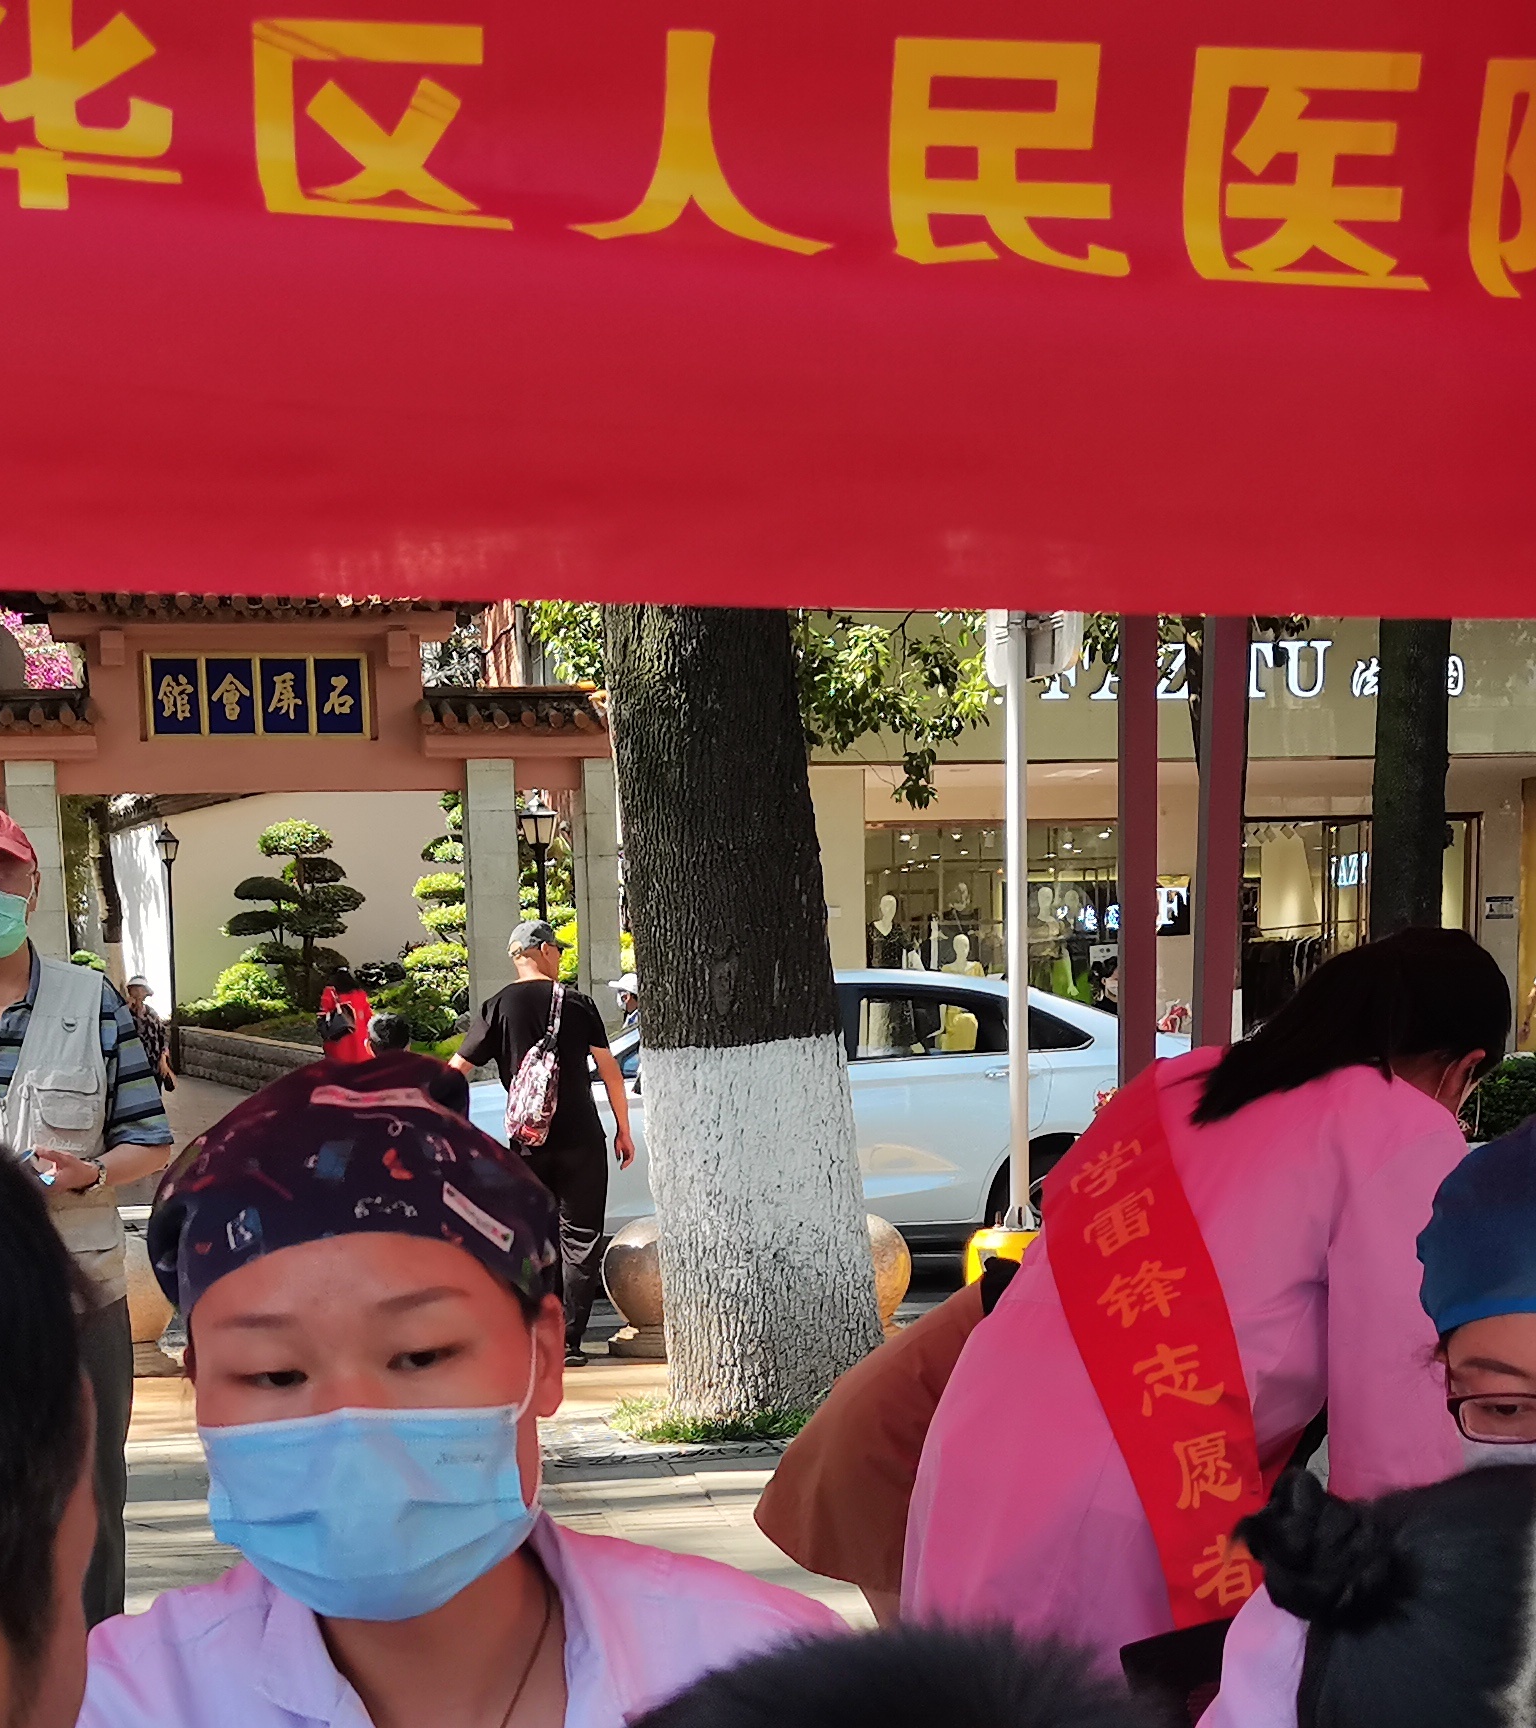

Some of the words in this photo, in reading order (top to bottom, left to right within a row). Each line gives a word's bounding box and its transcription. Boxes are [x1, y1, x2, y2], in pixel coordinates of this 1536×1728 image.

[1071, 1138, 1260, 1607] 学雷锋志愿者
